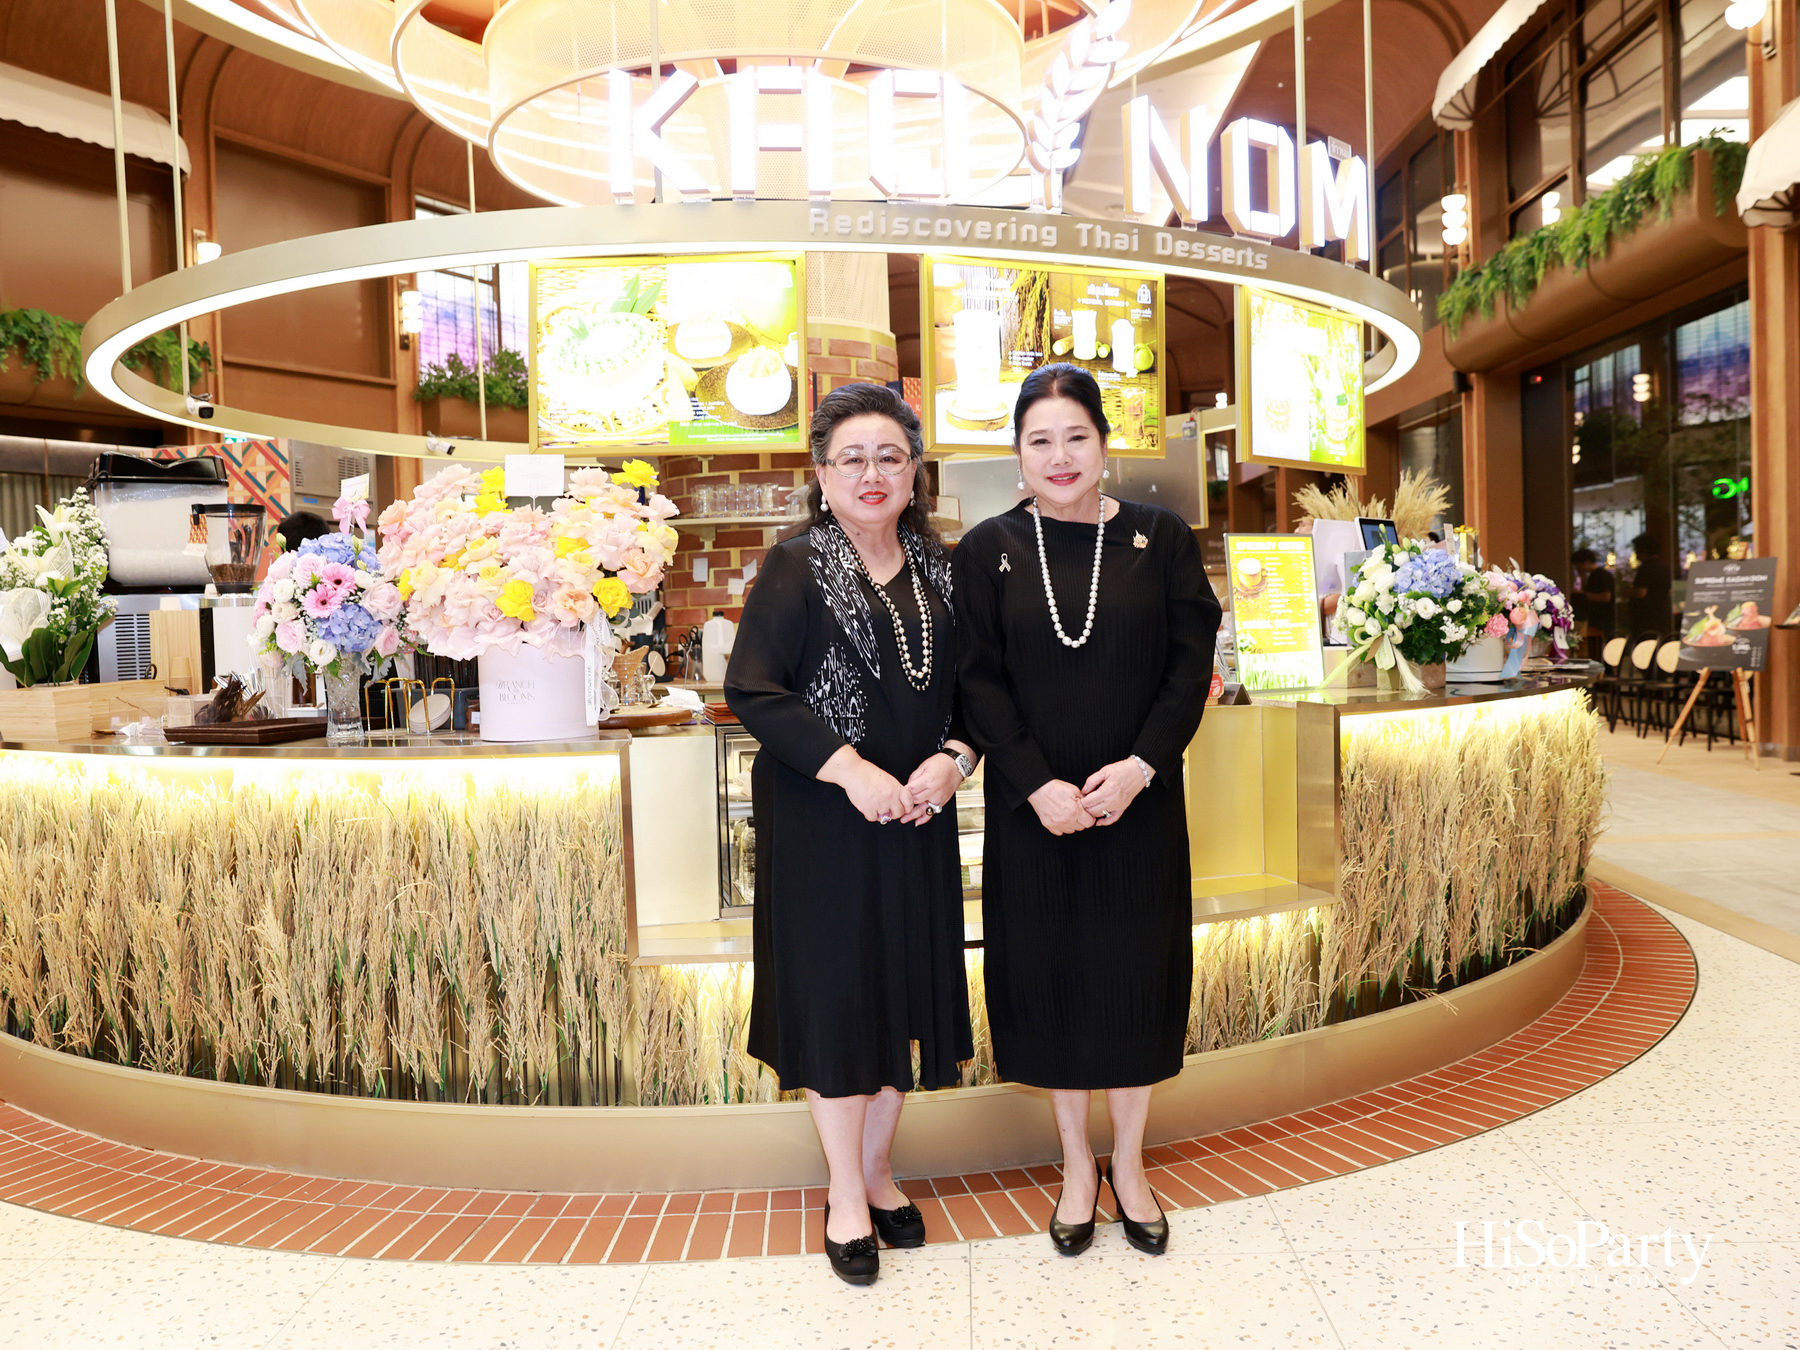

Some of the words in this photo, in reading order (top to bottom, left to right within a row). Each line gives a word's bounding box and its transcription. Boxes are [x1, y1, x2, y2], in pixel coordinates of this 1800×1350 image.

[609, 65, 967, 201] KAO
[1121, 94, 1369, 261] NOM
[808, 207, 1058, 248] Rediscovering
[1077, 222, 1140, 252] Thai
[1155, 233, 1269, 270] Desserts
